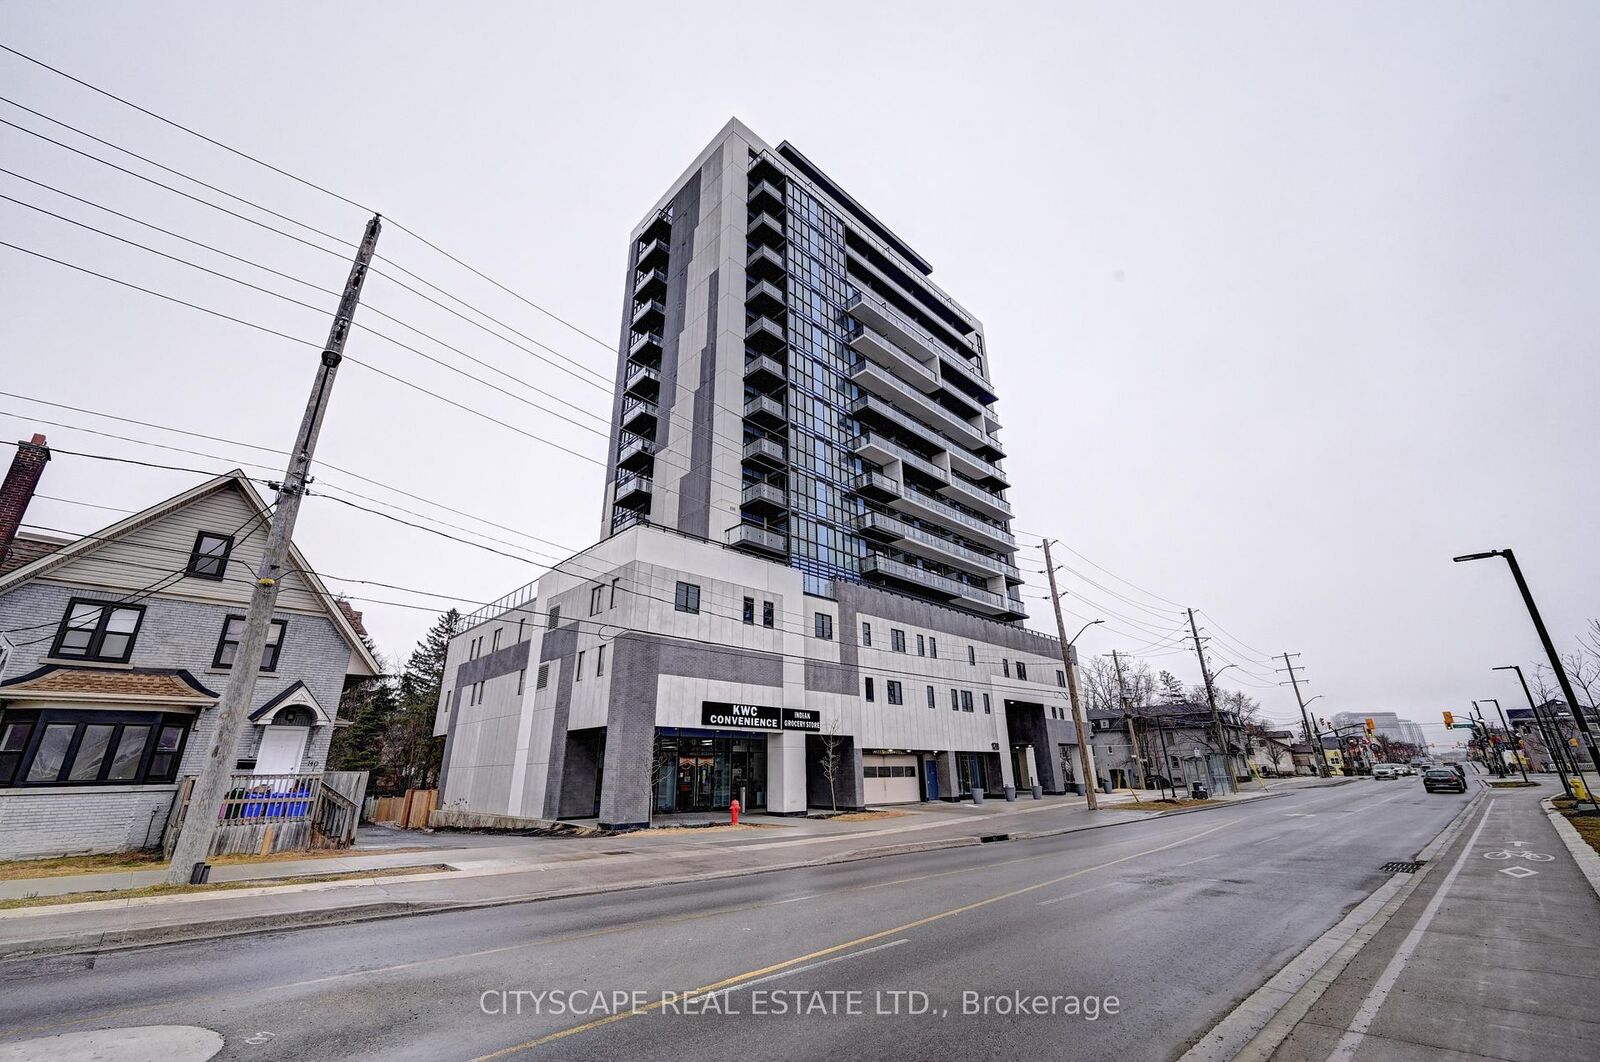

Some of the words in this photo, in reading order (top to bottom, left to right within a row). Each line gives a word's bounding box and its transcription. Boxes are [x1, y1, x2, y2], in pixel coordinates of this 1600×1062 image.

[732, 705, 758, 717] KWC
[794, 711, 811, 719] INDIAN
[710, 715, 778, 727] CONVENIENCE
[784, 720, 806, 728] GROCERY
[806, 721, 820, 729] STORE
